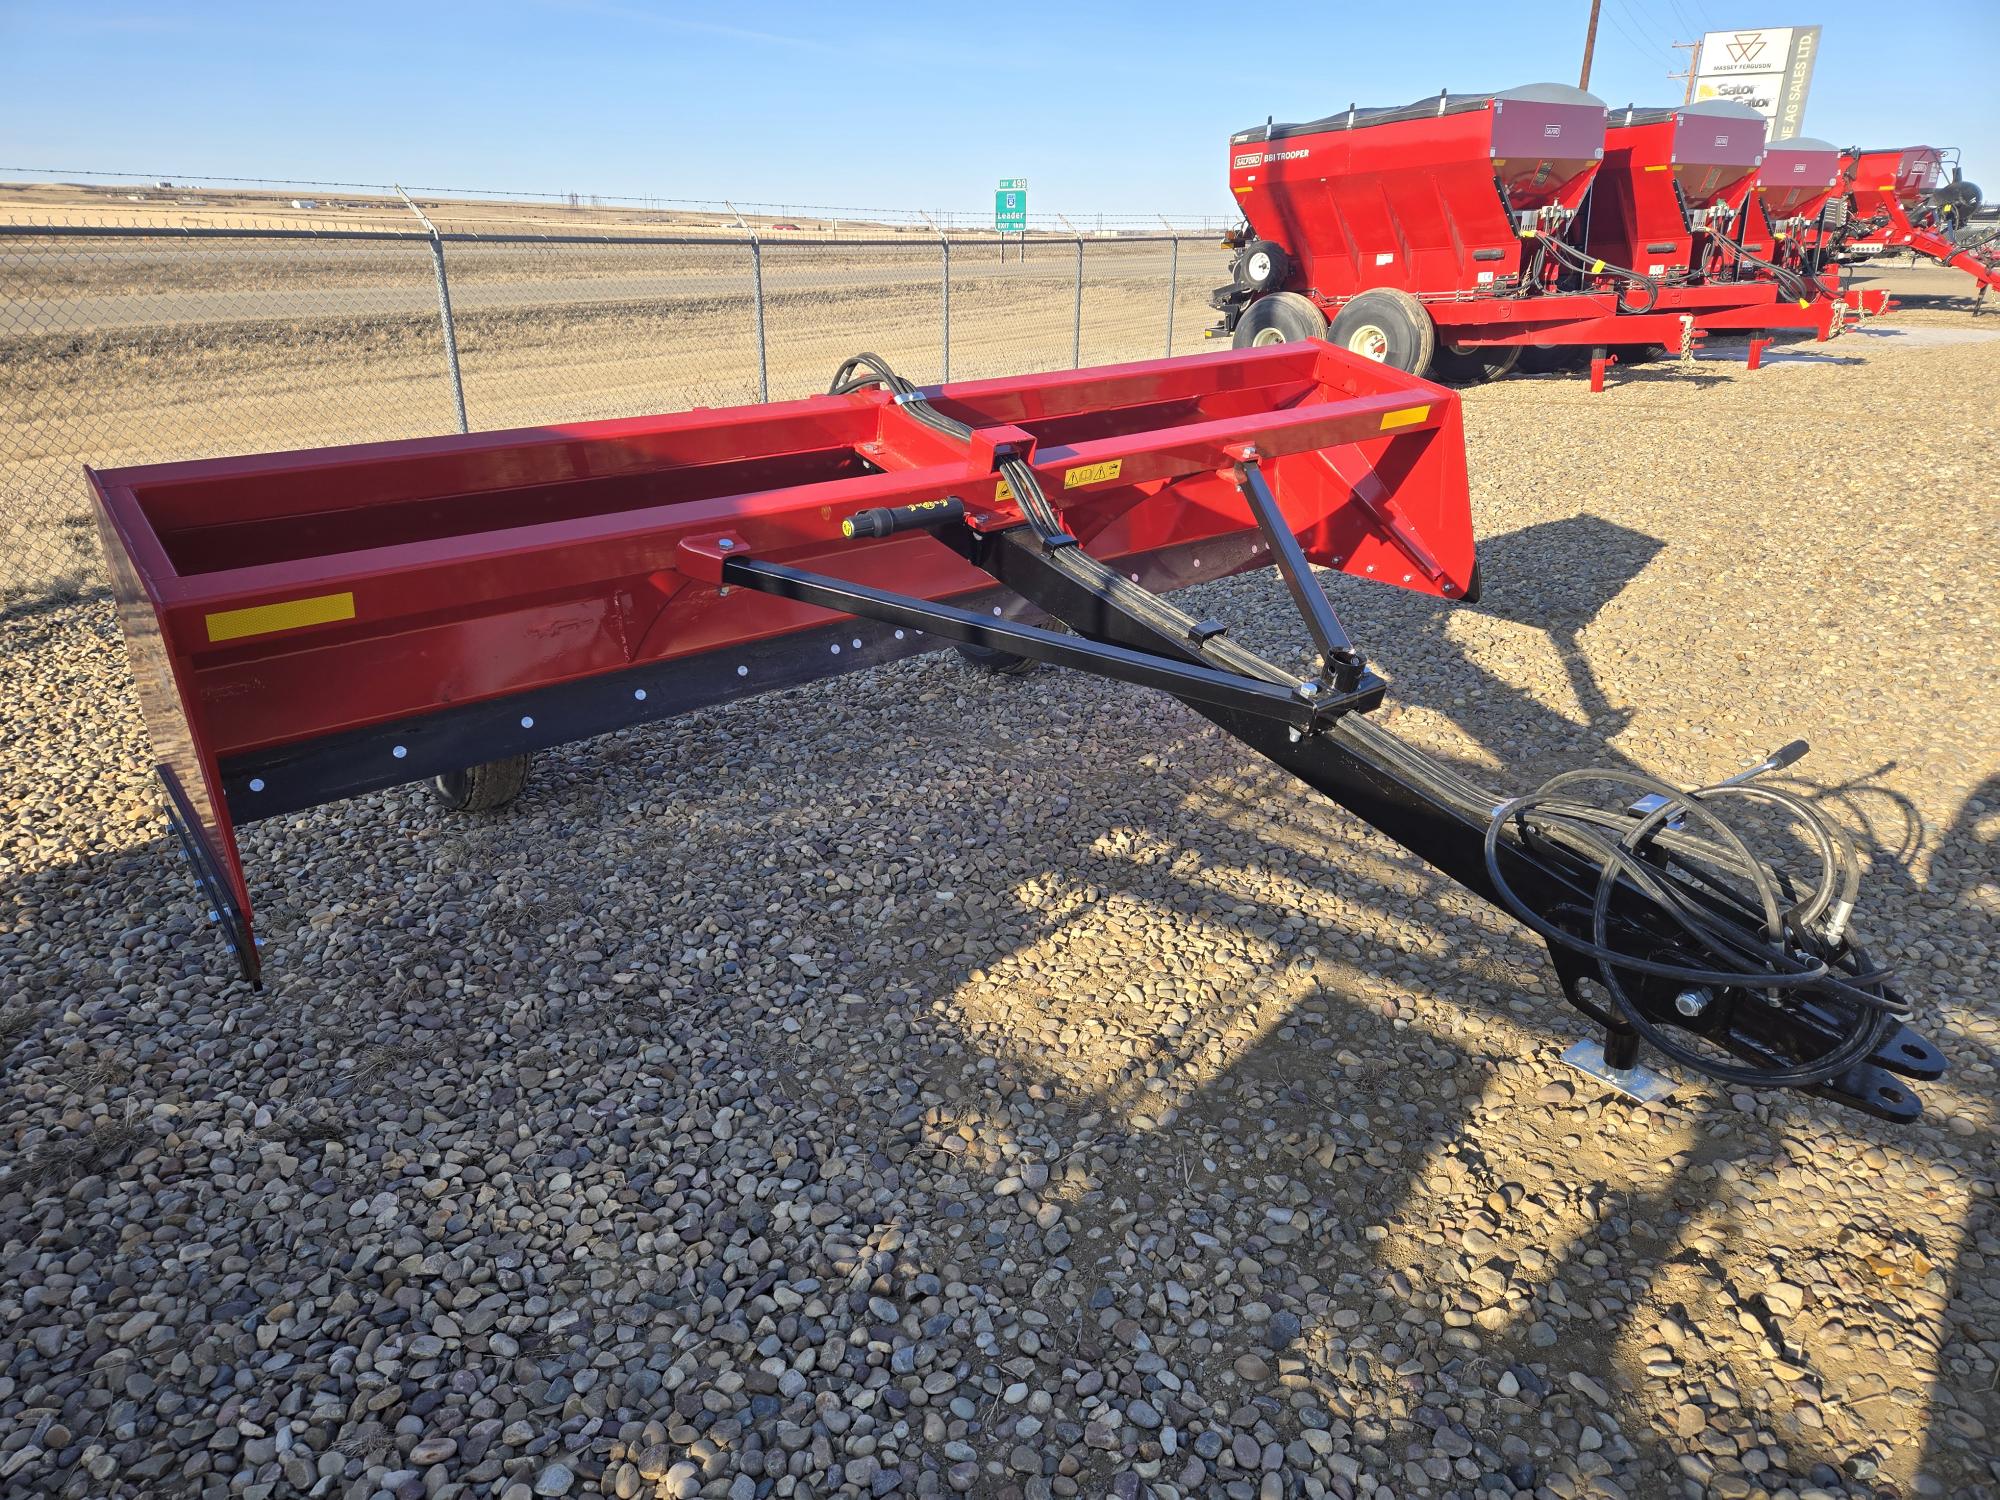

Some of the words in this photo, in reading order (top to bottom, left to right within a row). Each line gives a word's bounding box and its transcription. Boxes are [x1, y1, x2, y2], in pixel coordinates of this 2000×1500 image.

[1797, 32, 1814, 58] LTD.
[1789, 62, 1807, 102] SALES
[1785, 102, 1799, 123] AG
[1236, 155, 1260, 167] SALFORD
[1264, 153, 1276, 162] BBI
[1276, 149, 1310, 161] TROOPER
[1012, 179, 1026, 188] 499
[997, 212, 1024, 220] Leader
